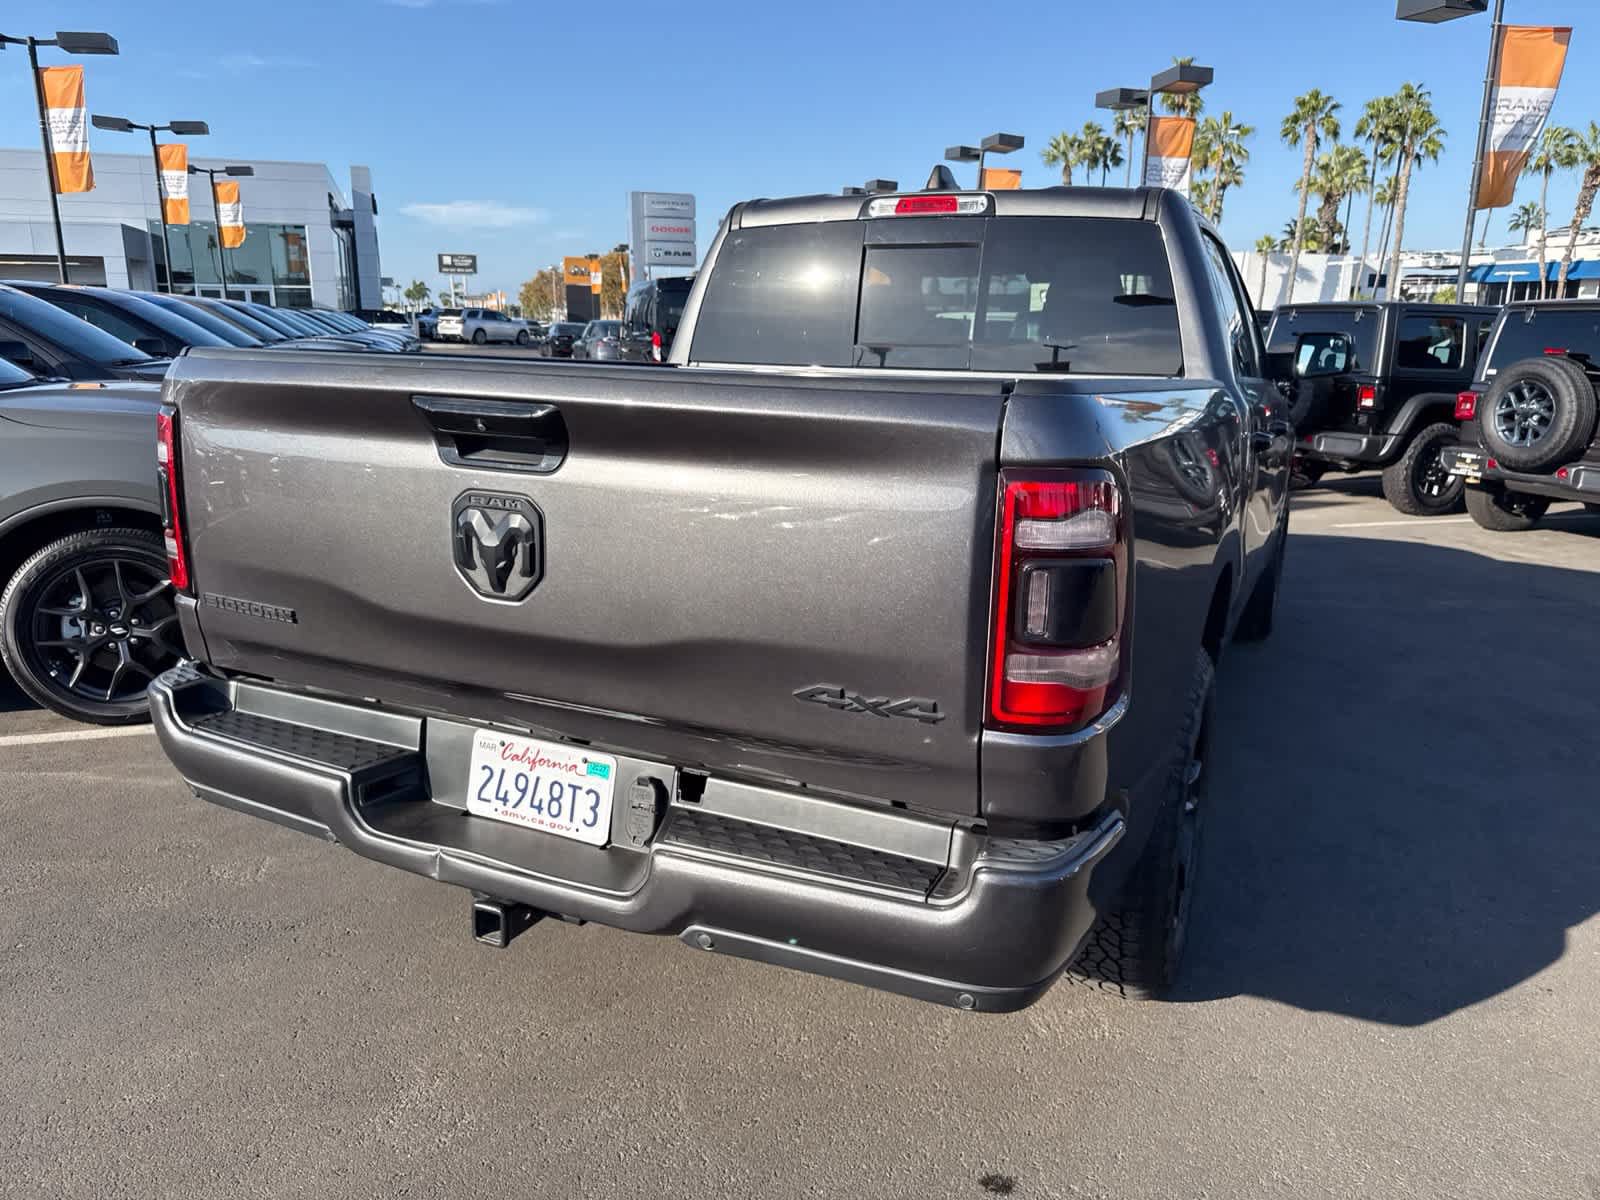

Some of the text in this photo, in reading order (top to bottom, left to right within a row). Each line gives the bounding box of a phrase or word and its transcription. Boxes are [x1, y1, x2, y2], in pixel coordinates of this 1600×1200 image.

[468, 495, 522, 509] RAM
[479, 740, 497, 753] MAR
[500, 742, 587, 777] California
[476, 764, 601, 828] 24948T3
[501, 809, 573, 832] dmv.ca.gov
